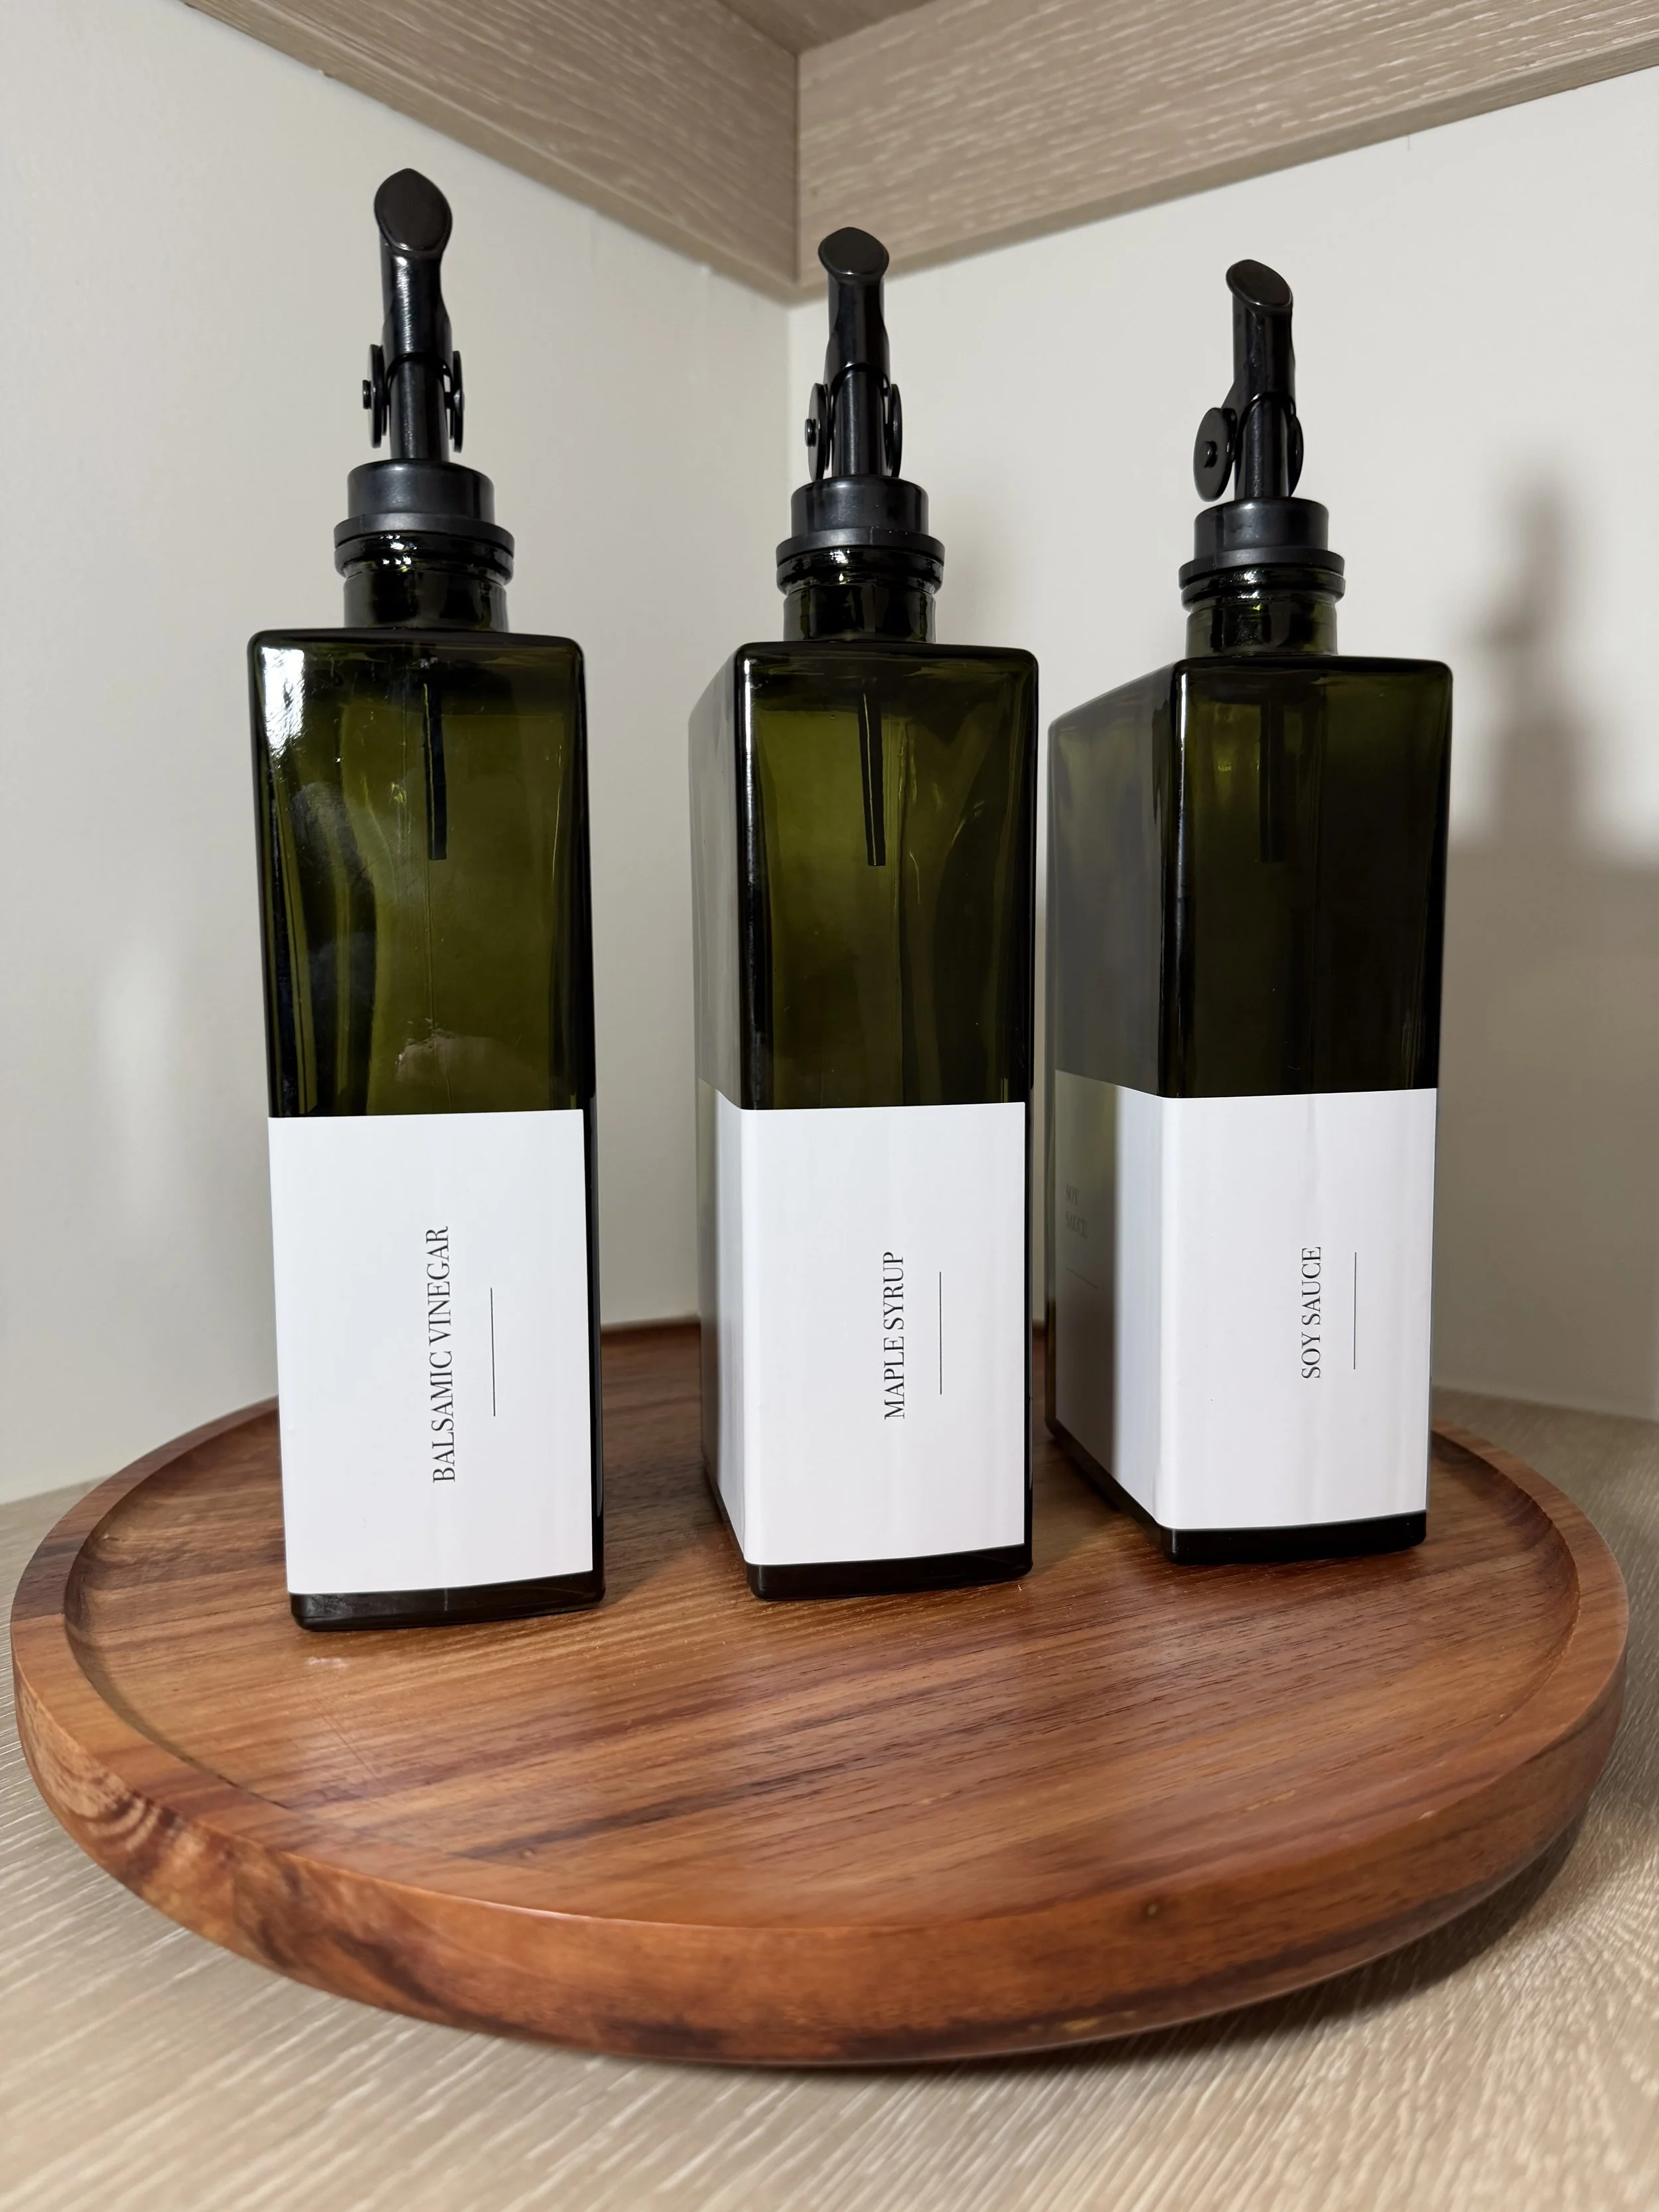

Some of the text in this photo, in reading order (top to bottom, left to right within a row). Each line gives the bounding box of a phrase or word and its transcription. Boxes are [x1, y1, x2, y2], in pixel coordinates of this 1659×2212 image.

[425, 1226, 455, 1482] BALSAMIC VINEGAR
[883, 1252, 904, 1420] MAPLE SYRUP
[1301, 1246, 1321, 1378] SOY SAUCE
